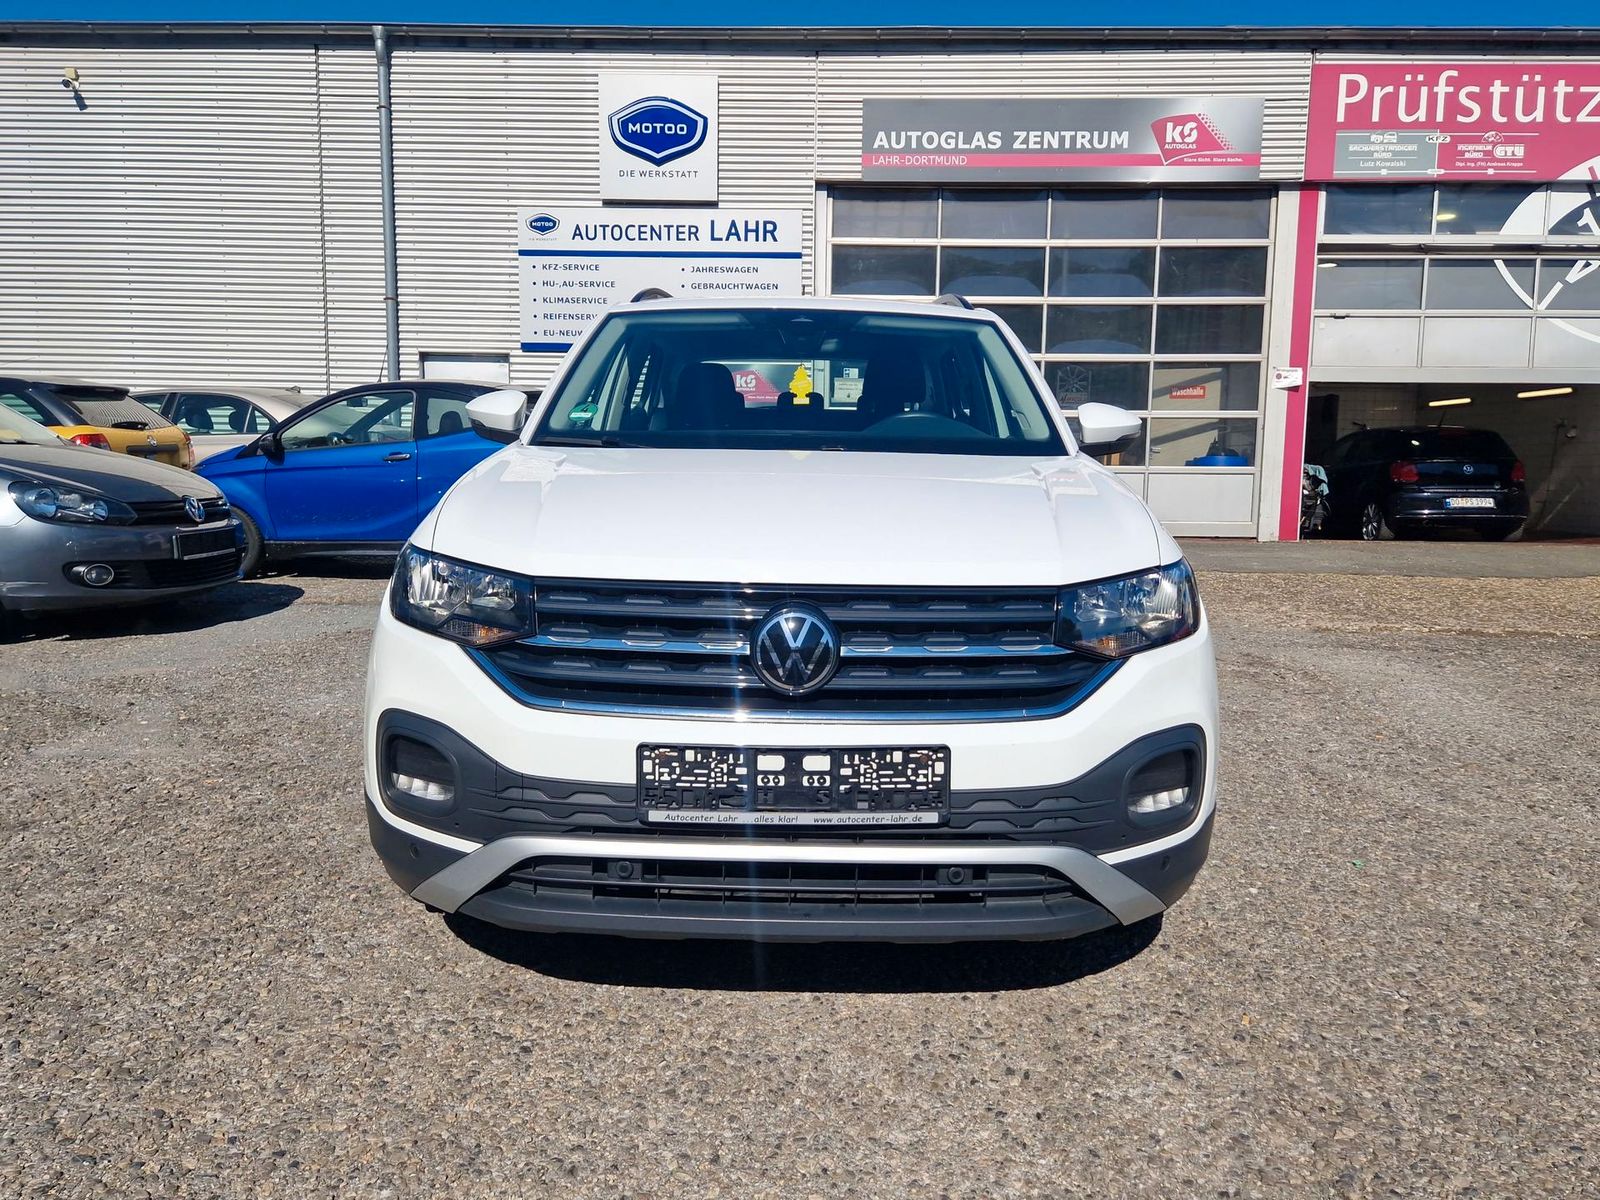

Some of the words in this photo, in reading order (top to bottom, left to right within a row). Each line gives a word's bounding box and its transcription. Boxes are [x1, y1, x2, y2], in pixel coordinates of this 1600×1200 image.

[628, 122, 687, 135] MOTOO
[872, 130, 1003, 150] AUTOGLAS
[1012, 130, 1130, 150] ZENTRUM
[872, 154, 968, 166] LAHR-DORTMUND
[619, 169, 636, 178] DIE
[639, 169, 699, 179] WERKSTATT
[571, 223, 700, 242] AUTOCENTER
[709, 219, 779, 243] LAHR
[542, 263, 600, 272] KFZ-SERVICE
[690, 265, 759, 274] JAHRESWAGEN
[542, 279, 616, 289] HU-,AU-SERVICE
[690, 282, 779, 291] GEBRAUCHTWAGEN
[543, 296, 608, 306] KLIMASERVICE
[664, 813, 715, 823] Autocenter
[717, 814, 738, 823] Lahr
[813, 814, 923, 825] www.autocenter-lahr.de
